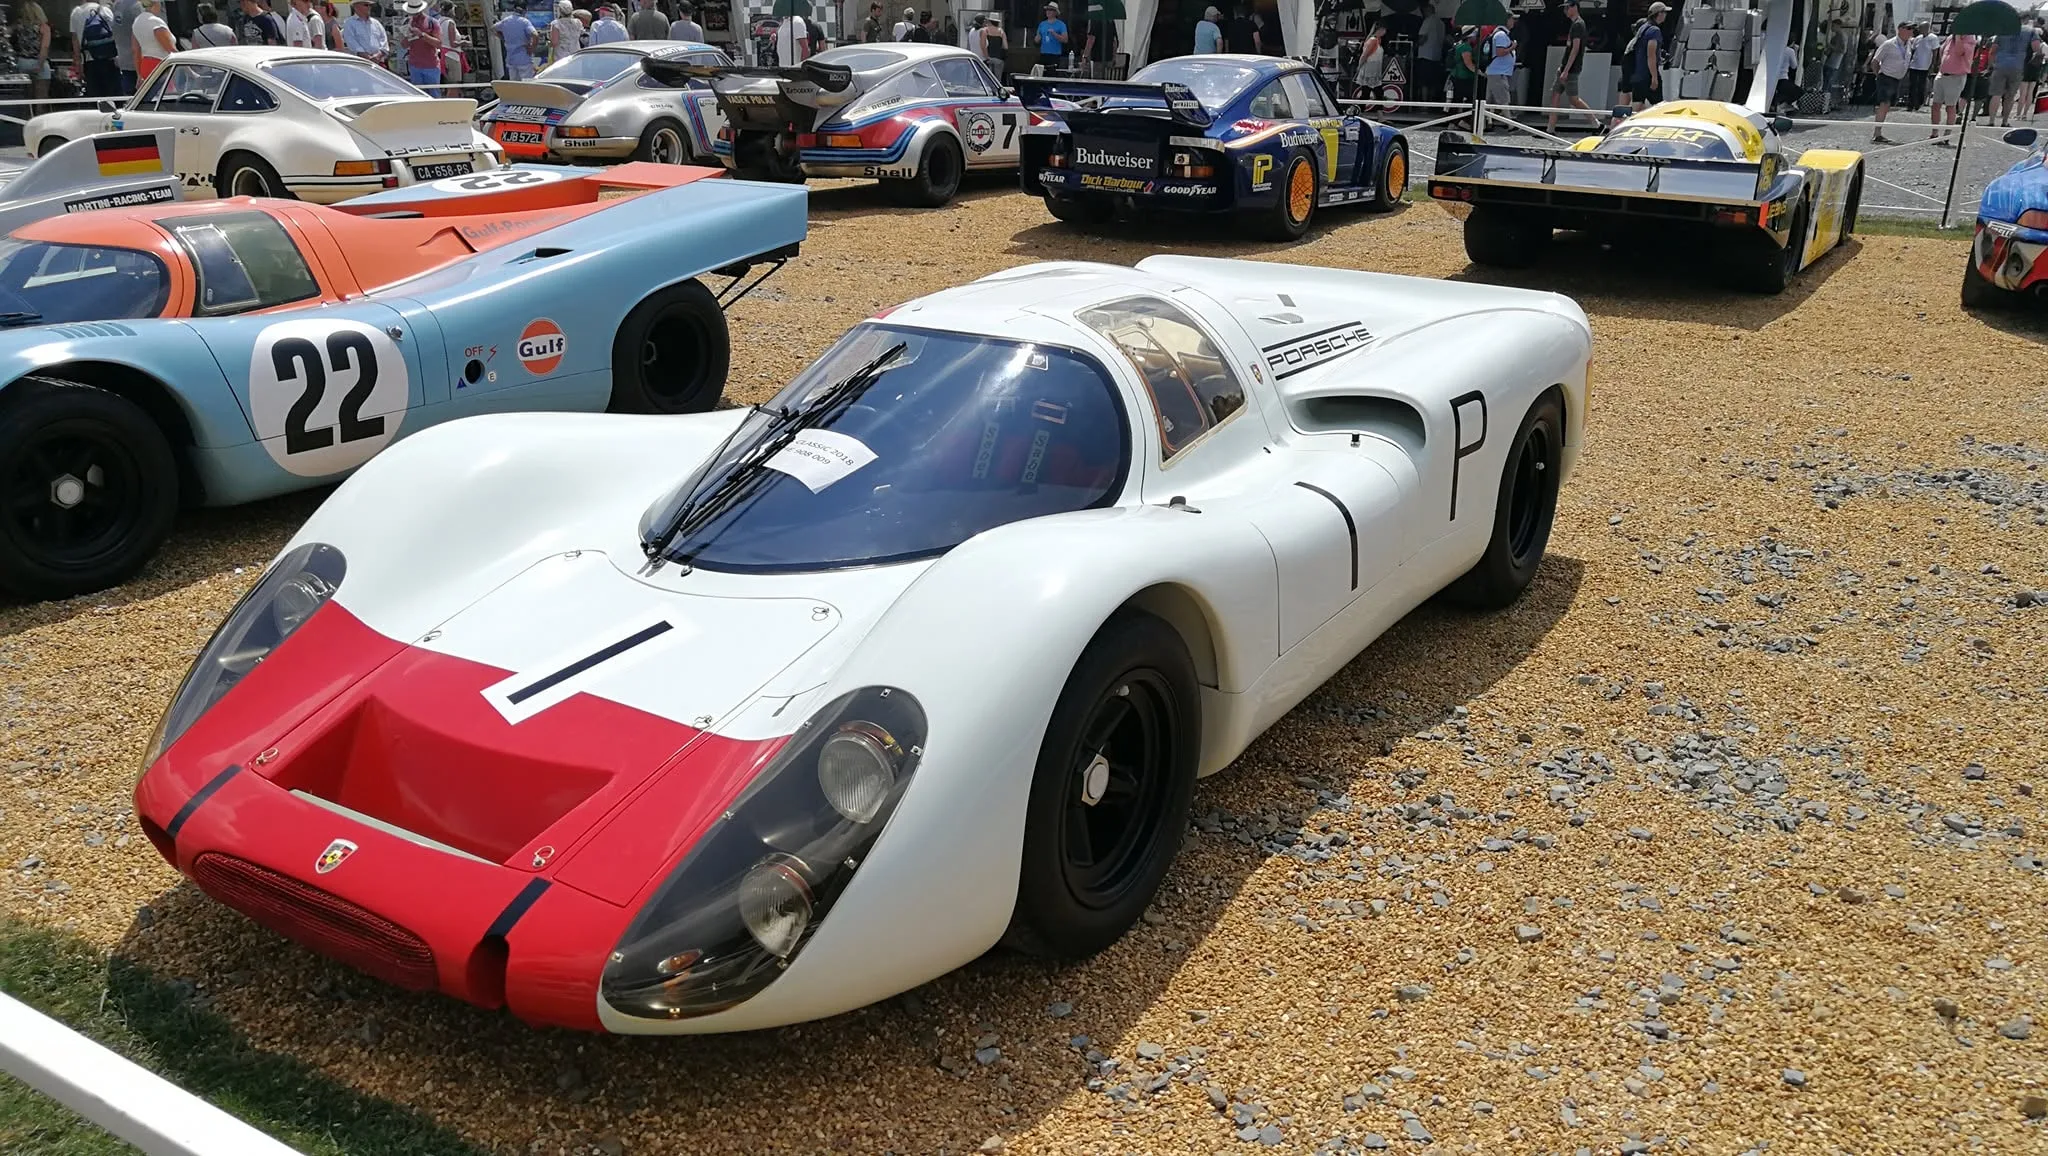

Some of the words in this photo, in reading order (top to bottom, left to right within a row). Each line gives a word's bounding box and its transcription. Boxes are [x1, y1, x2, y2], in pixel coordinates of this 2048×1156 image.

[725, 95, 751, 104] VASEK
[752, 95, 776, 104] POLAK
[871, 97, 901, 110] DUNLOP
[505, 104, 547, 116] MARTINI
[502, 131, 519, 142] XJB
[519, 132, 542, 143] 572L
[1002, 113, 1017, 149] 7
[1279, 130, 1319, 148] Budweiser
[1076, 147, 1153, 170] Budweiser
[418, 163, 470, 180] CA-658-PS
[864, 167, 912, 178] Shell
[1080, 174, 1103, 186] Dick
[1103, 176, 1145, 190] Barbour
[1164, 184, 1217, 197] GOODYEAR
[464, 346, 484, 358] OFF
[519, 337, 565, 358] Gulf
[1267, 328, 1374, 371] PORSCHE
[271, 329, 385, 456] 22
[796, 439, 831, 452] CLASSIC
[830, 448, 854, 466] 2018
[811, 454, 831, 465] 009
[1448, 389, 1488, 521] P
